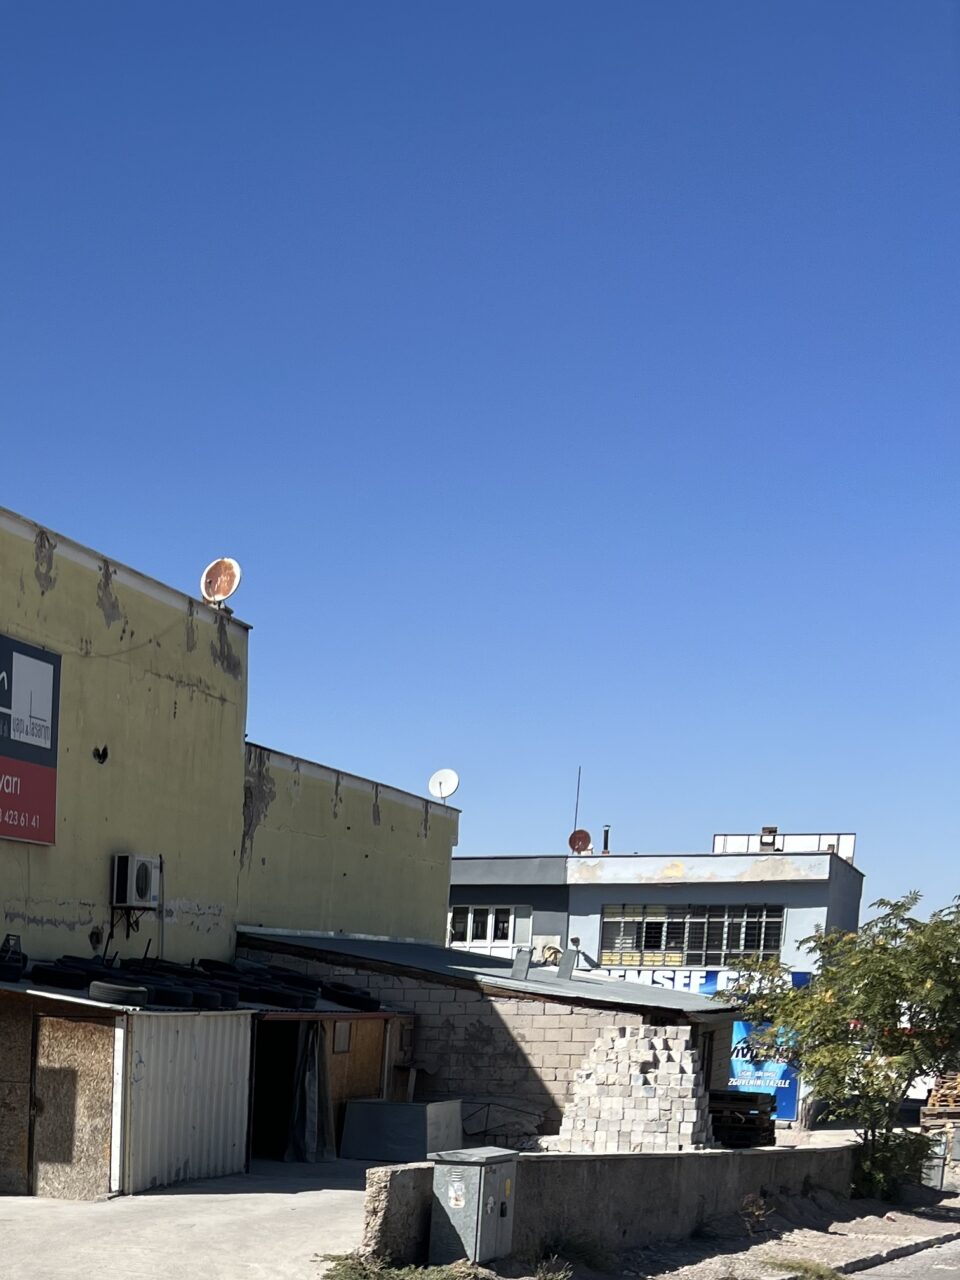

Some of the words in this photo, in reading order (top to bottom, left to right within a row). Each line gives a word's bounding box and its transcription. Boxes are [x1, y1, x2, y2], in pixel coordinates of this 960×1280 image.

[4, 809, 18, 825] 423
[20, 812, 29, 827] 61
[31, 814, 40, 829] 41
